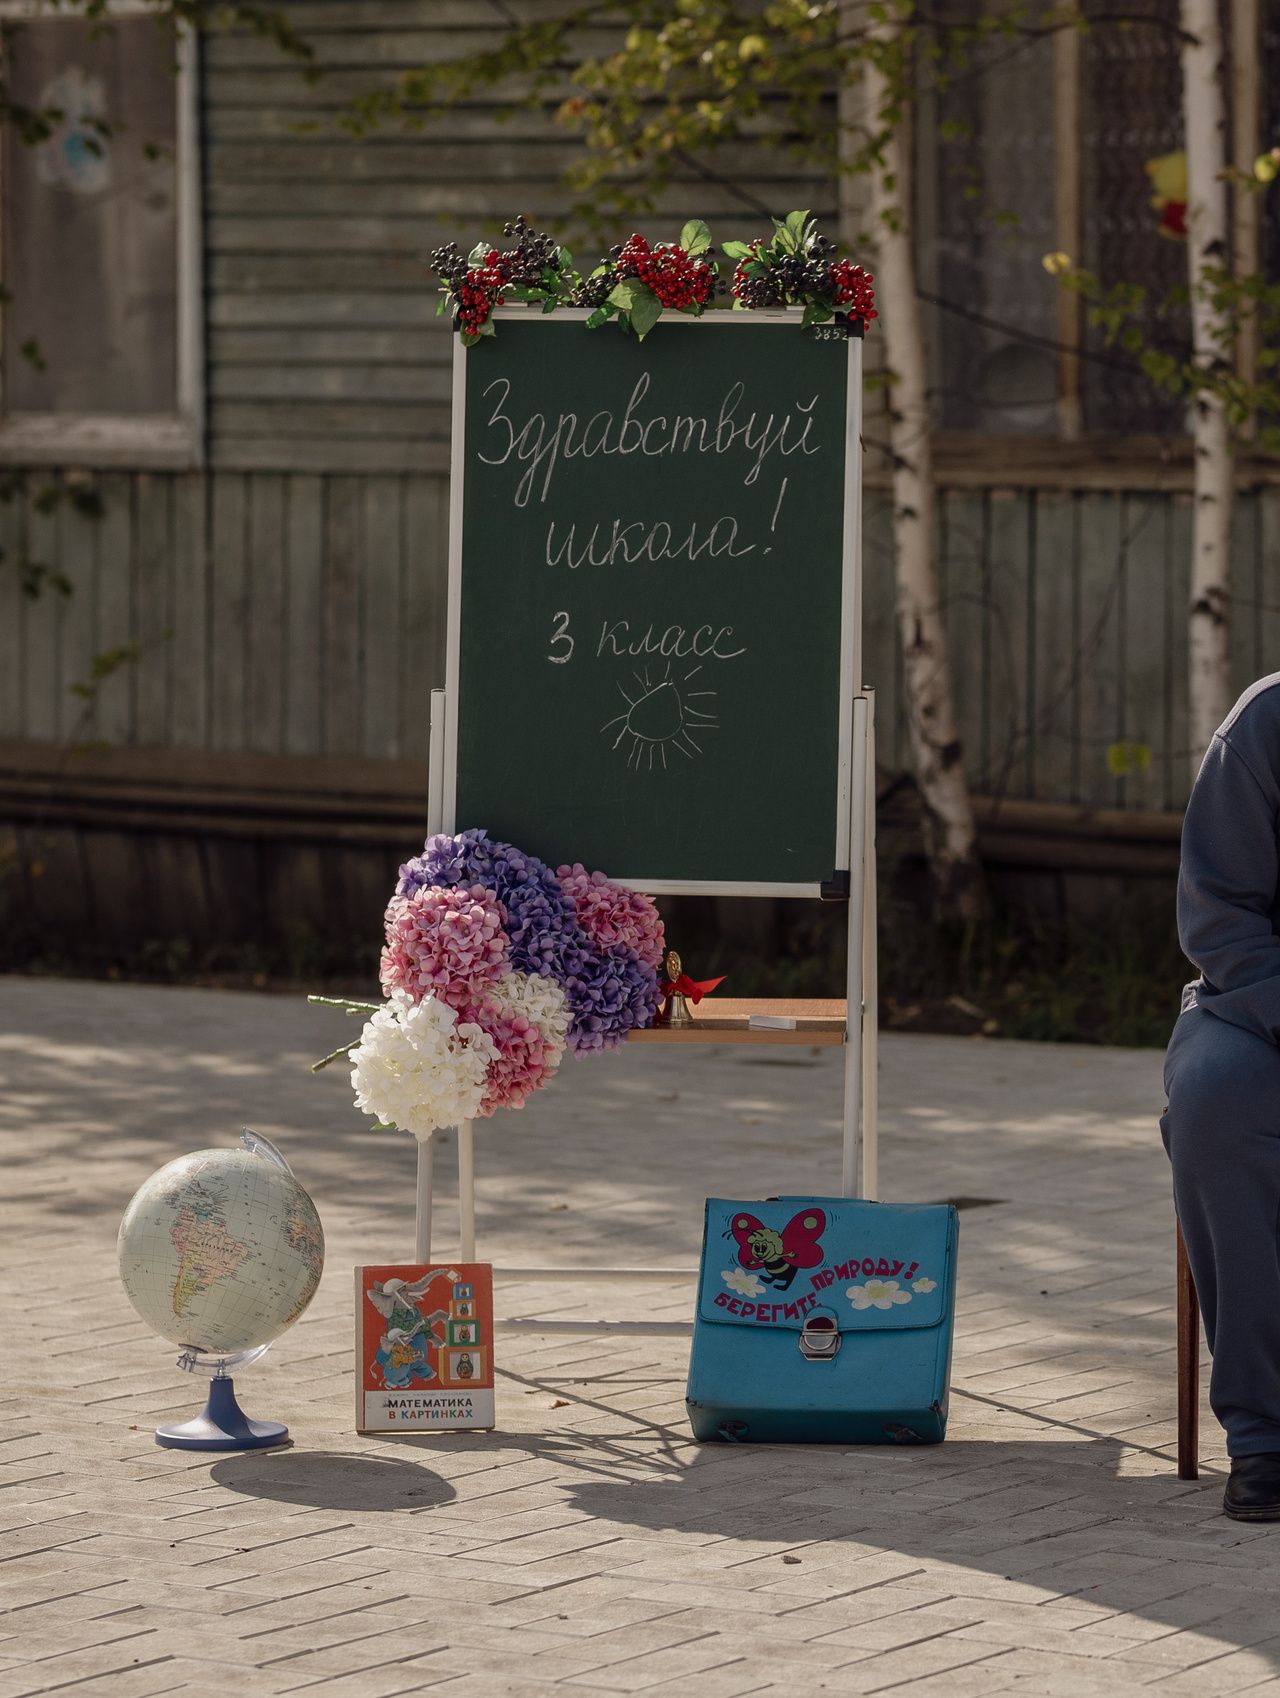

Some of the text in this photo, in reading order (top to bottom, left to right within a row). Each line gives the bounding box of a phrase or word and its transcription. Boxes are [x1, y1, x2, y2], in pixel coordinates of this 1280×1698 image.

[477, 372, 821, 508] Здравствуй
[545, 477, 788, 569] школа!
[547, 611, 748, 664] 3 класс
[809, 1257, 920, 1292] ПРИРОДУ!
[388, 1398, 473, 1408] МАТЕМАТИКА
[388, 1410, 473, 1419] В КАРТИНКАХ
